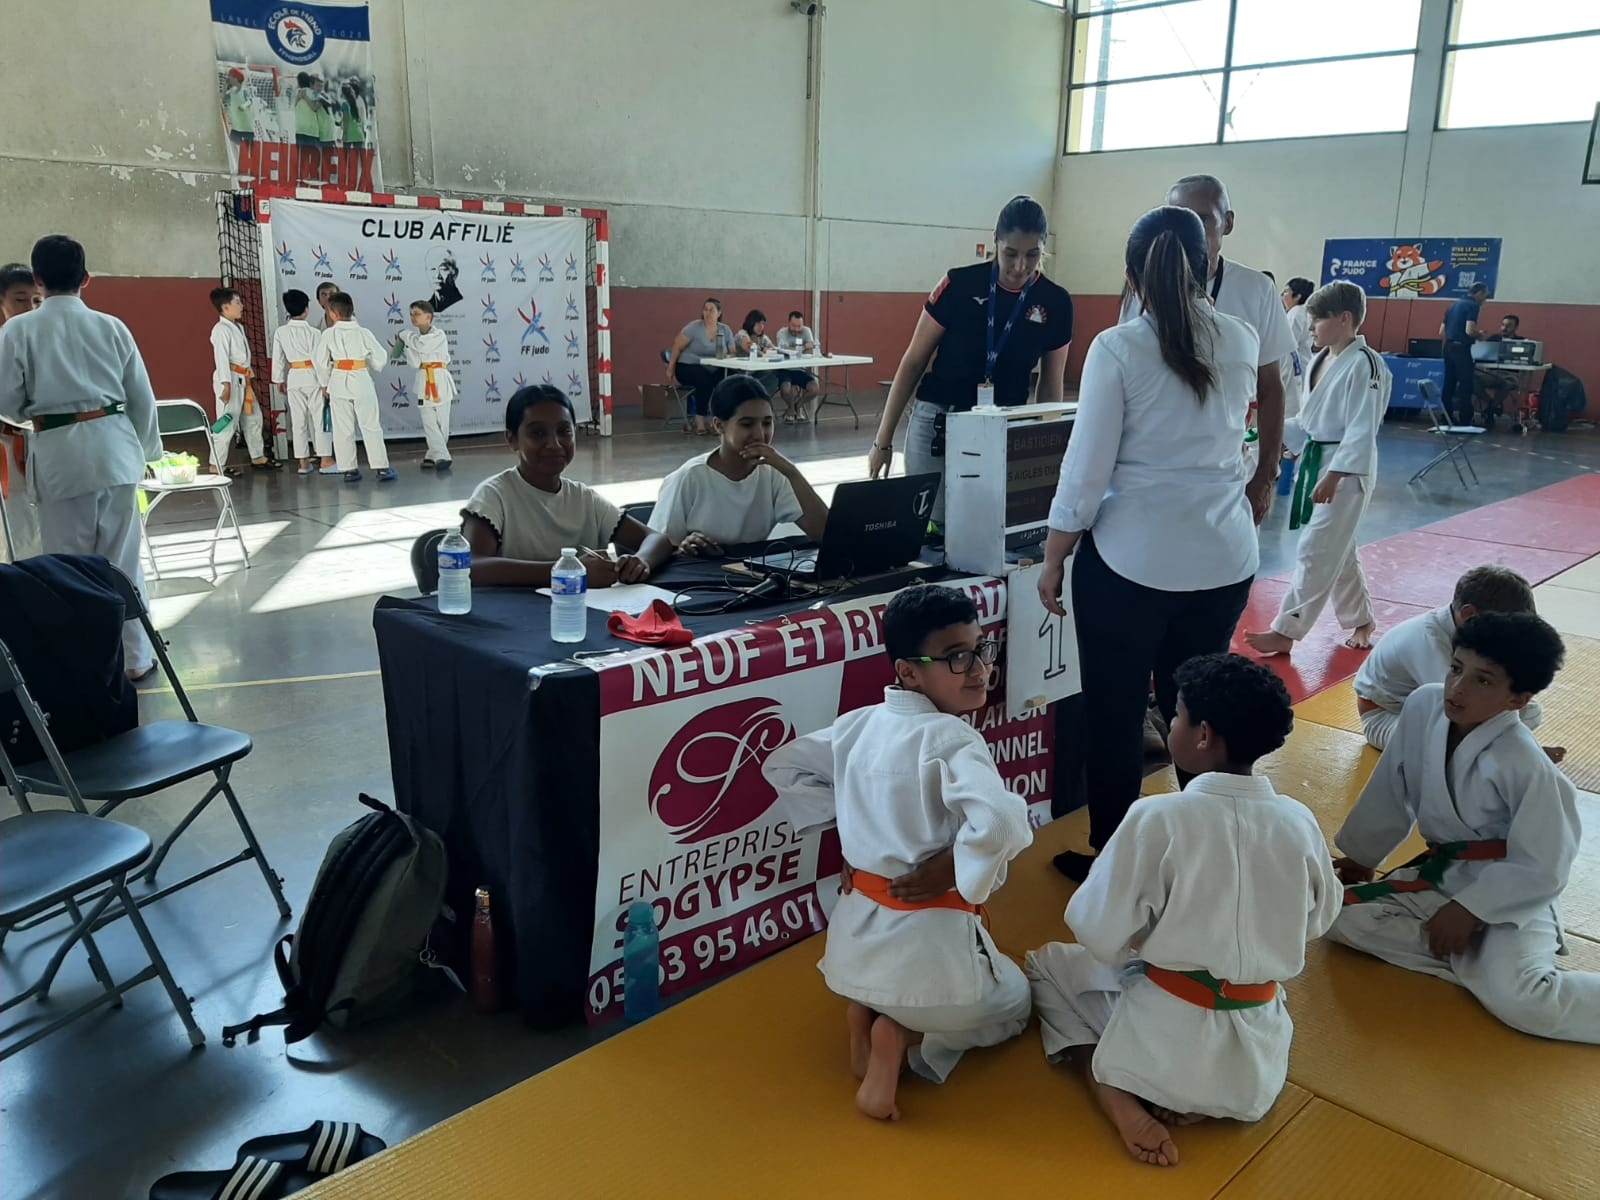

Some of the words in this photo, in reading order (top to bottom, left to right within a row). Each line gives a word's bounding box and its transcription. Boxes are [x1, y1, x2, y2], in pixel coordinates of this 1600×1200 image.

[220, 12, 256, 26] LABEL
[268, 8, 289, 30] ECOLE
[238, 139, 375, 192] HEUREUX
[361, 218, 424, 240] CLUB
[430, 222, 515, 244] AFFILIÉ
[1342, 260, 1378, 268] FRANCE
[1342, 268, 1366, 276] JUDO
[520, 345, 530, 355] FF
[532, 345, 550, 356] judo
[1014, 466, 1043, 480] AIGLES
[864, 520, 896, 532] TOSHIBA
[1039, 600, 1066, 680] 1
[630, 633, 760, 702] NEUF
[776, 617, 829, 669] ET
[588, 967, 625, 1010] 05
[693, 925, 737, 970] 95
[742, 908, 779, 947] 46
[782, 892, 815, 930] 07
